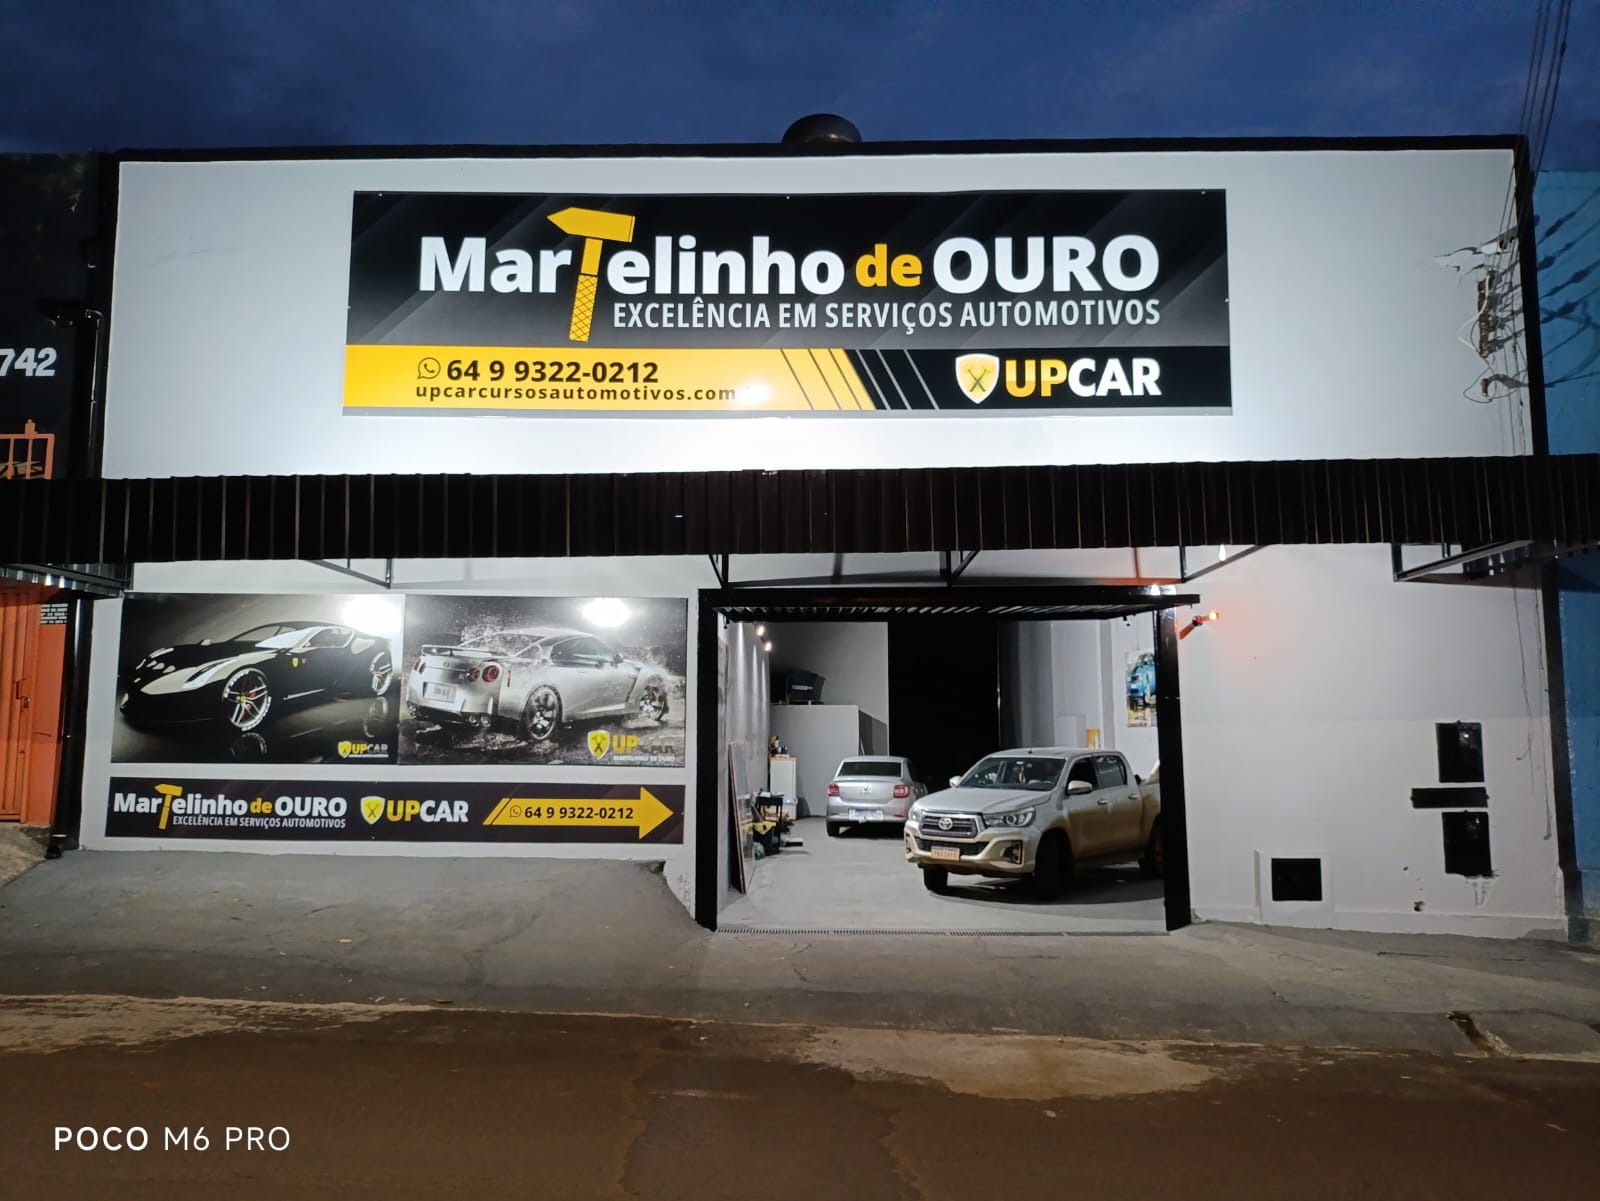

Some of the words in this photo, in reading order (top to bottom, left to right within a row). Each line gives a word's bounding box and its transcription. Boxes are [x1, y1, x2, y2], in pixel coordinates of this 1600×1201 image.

[855, 243, 922, 287] de
[933, 234, 1159, 294] OURO
[613, 296, 771, 328] EXCELÊNCIA
[779, 302, 817, 328] EM
[824, 301, 953, 335] SERVIÇOS
[959, 299, 1161, 327] AUTOMOTIVOS
[446, 359, 480, 382] 64
[489, 360, 505, 382] 9
[514, 361, 659, 383] 9322-0212
[1004, 357, 1163, 398] UPCAR
[415, 384, 737, 402] upcarcursosautomotivos.com
[249, 797, 273, 815] de
[274, 796, 347, 818] OURO
[386, 799, 469, 823] UPCAR
[524, 806, 542, 819] 64
[546, 807, 555, 819] 9
[559, 806, 634, 820] 9322-0212
[172, 813, 223, 827] EXCELÊNCIA
[224, 816, 238, 827] EM
[239, 815, 281, 830] SERVIÇOS
[282, 816, 346, 828] AUTOMOTIVOS
